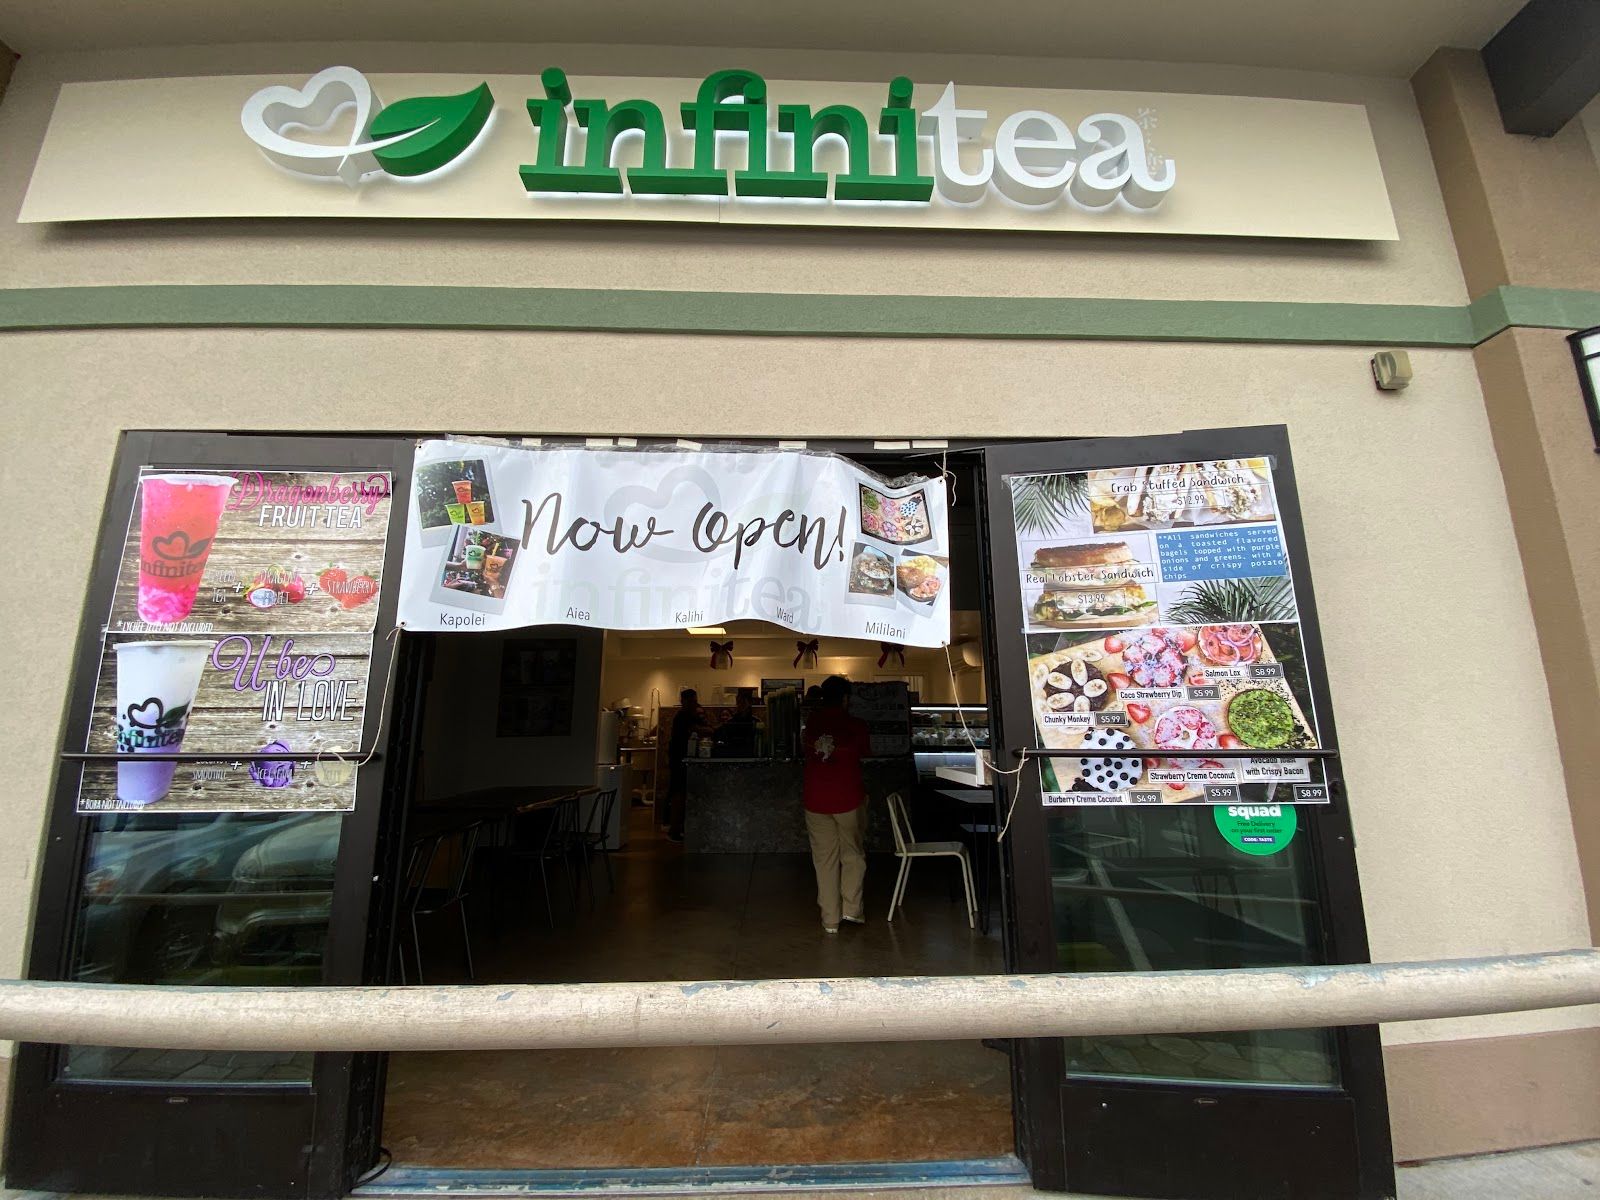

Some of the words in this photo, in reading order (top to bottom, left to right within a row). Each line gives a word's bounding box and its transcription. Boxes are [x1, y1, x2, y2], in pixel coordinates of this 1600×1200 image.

[518, 68, 1176, 208] infinitea
[1111, 483, 1137, 493] Crab
[1190, 474, 1244, 487] Sandwich
[225, 471, 389, 515] Dragonberry
[259, 505, 322, 528] FRUIT
[325, 505, 362, 528] TEA
[521, 492, 674, 555] Now
[692, 500, 848, 571] Open!
[1190, 531, 1239, 540] sandwiches
[1247, 528, 1277, 536] served
[1191, 539, 1228, 547] toasted
[1236, 535, 1278, 544] flavored
[1160, 549, 1188, 558] bagels
[1194, 546, 1222, 555] topped
[1227, 545, 1246, 553] with
[1251, 543, 1280, 551] purple
[1161, 557, 1189, 565] onions
[1195, 555, 1209, 563] and
[1210, 561, 1242, 570] crispy
[1250, 559, 1283, 568] potato
[1026, 573, 1048, 583] Real
[1101, 567, 1154, 580] Sandwich
[1163, 573, 1187, 581] chips
[440, 612, 486, 629] Kapolei
[566, 606, 591, 621] Aiea
[675, 610, 703, 623] Kalihi
[776, 606, 794, 624] Ward
[865, 620, 906, 639] Mililani
[1205, 669, 1230, 678] Salmon
[1231, 669, 1241, 677] Lox
[1255, 667, 1276, 676] $8.99
[1120, 691, 1136, 699] Coco
[1137, 690, 1170, 700] Strawberry
[1172, 690, 1182, 700] Dip
[1193, 689, 1214, 697] $5.99
[262, 680, 287, 721] IN
[296, 680, 358, 721] LOVE
[1044, 715, 1066, 726] Chunky
[1068, 715, 1091, 726] Monkey
[1100, 715, 1121, 723] $5.99
[1150, 771, 1185, 781] Strawberry
[1186, 772, 1207, 780] Creme
[1208, 771, 1235, 780] Coconut
[1246, 767, 1260, 776] with
[1261, 767, 1282, 776] Crispy
[1284, 766, 1304, 775] Bacon
[1210, 788, 1232, 797] $5.99
[1301, 789, 1322, 797] $8.99
[1048, 795, 1076, 804] Burberry
[1076, 795, 1097, 803] Creme
[1097, 795, 1123, 803] Coconut
